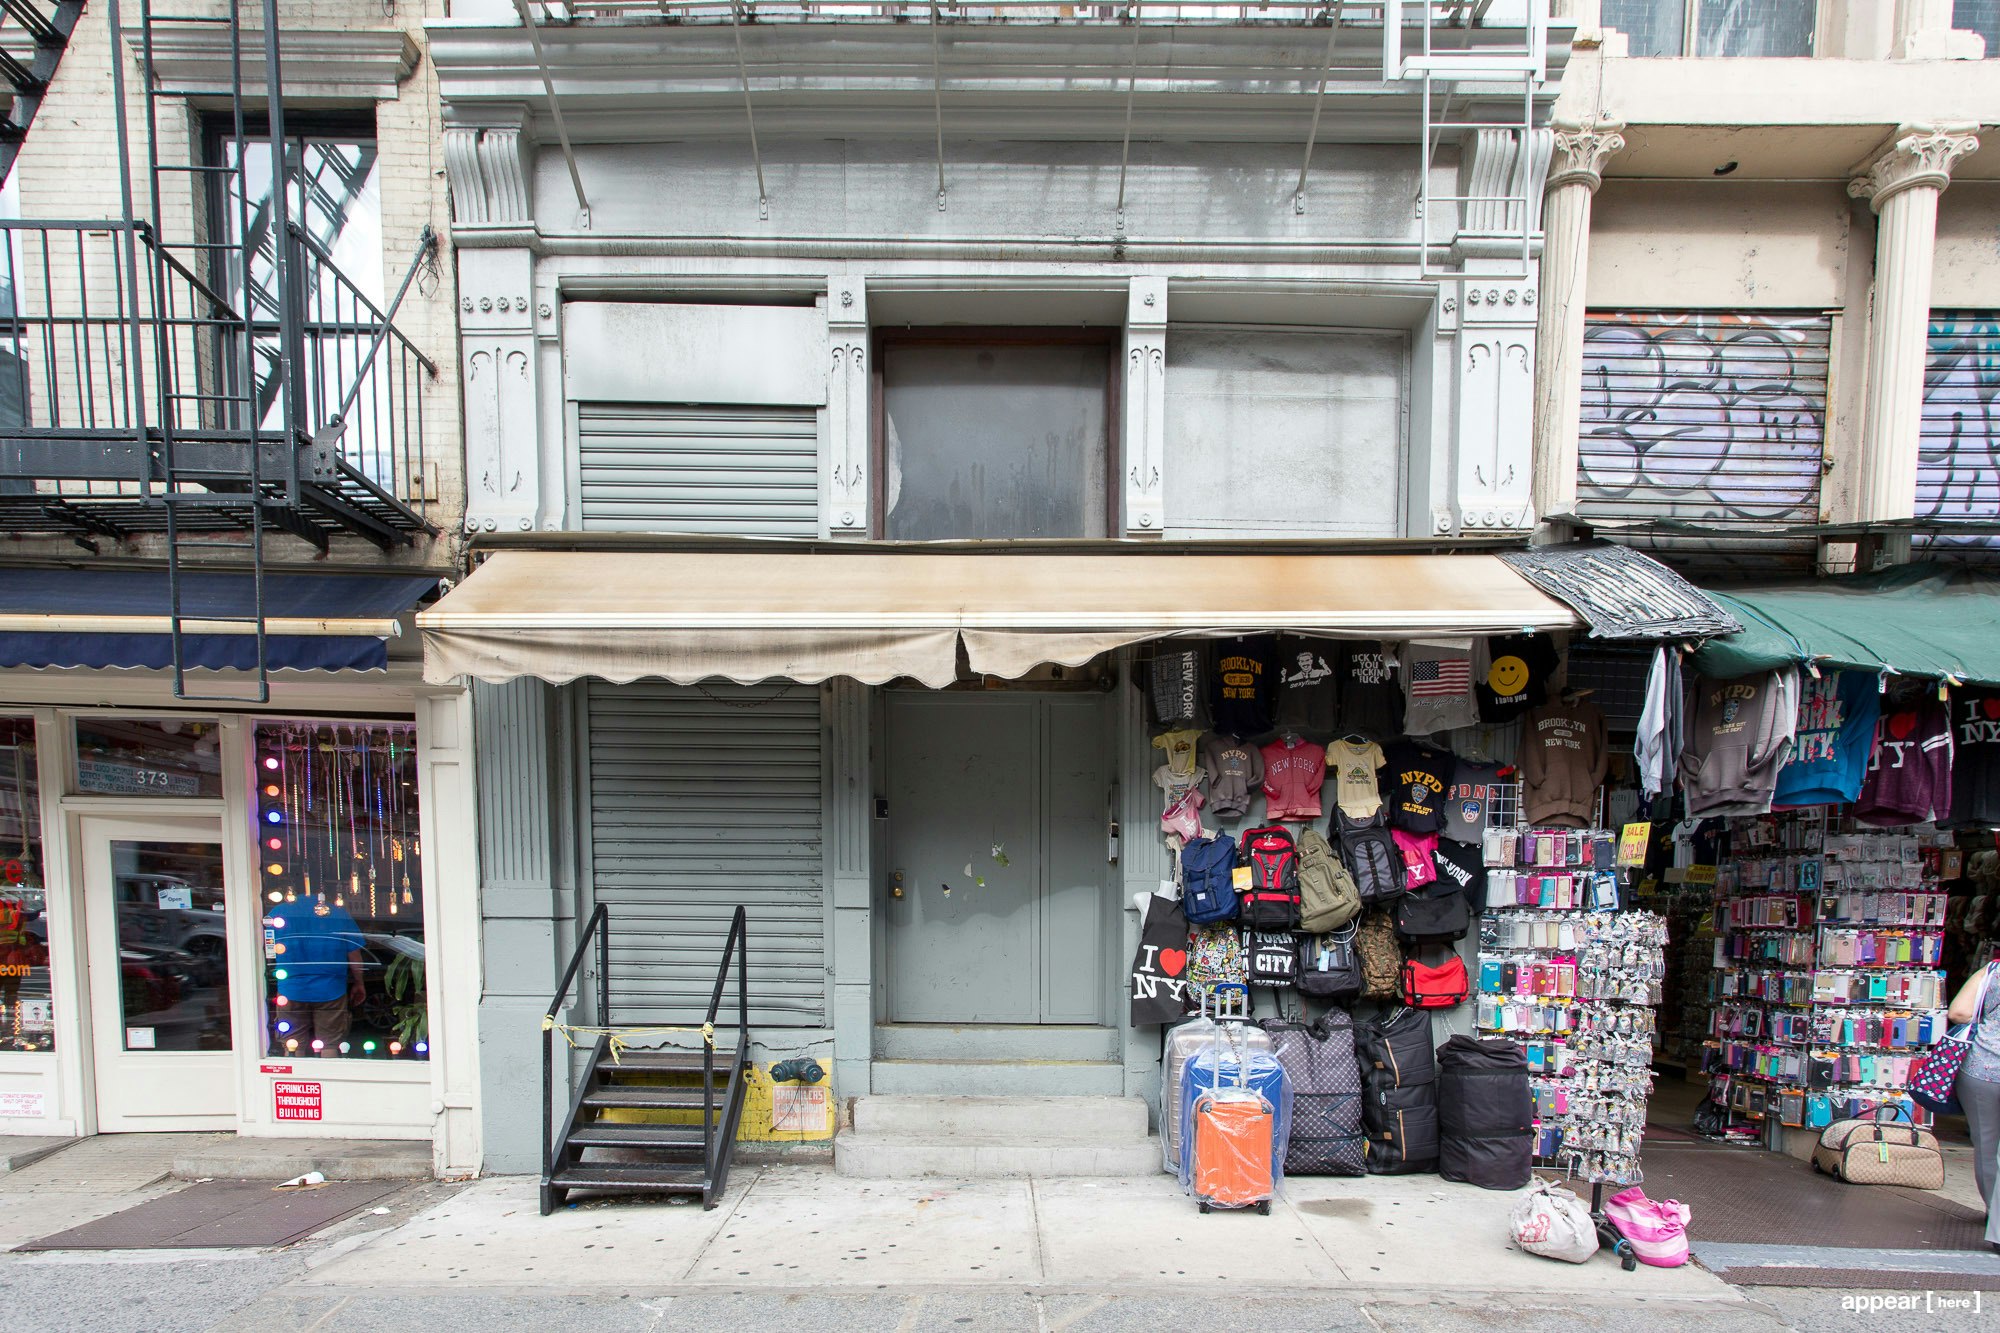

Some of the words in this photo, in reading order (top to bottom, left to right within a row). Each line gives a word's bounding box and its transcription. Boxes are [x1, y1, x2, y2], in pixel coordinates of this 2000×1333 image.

[1182, 651, 1194, 682] NEW
[1220, 656, 1263, 675] ROOKLYN
[1360, 661, 1379, 669] YOU
[1223, 687, 1238, 699] NEW
[1239, 687, 1256, 699] YORK
[1711, 684, 1757, 708] NYPD
[1802, 671, 1841, 704] EW
[1183, 684, 1194, 719] YORK
[1500, 696, 1514, 704] hate
[1514, 693, 1527, 703] you
[1964, 699, 1981, 721] I
[1545, 738, 1562, 747] NEW
[1563, 738, 1581, 749] YORK
[1221, 749, 1248, 761] NYPD
[1271, 758, 1290, 776] NEW
[1293, 757, 1315, 774] YORK
[136, 770, 169, 785] 373
[1400, 770, 1444, 793] NYPD
[1626, 827, 1645, 837] SALE
[1139, 945, 1159, 973] I
[1255, 953, 1293, 974] CITY
[1132, 973, 1188, 1002] NY
[276, 1084, 320, 1094] SPRINKLERS
[276, 1096, 320, 1106] THROUGHOUT
[279, 1108, 319, 1118] BUILDING
